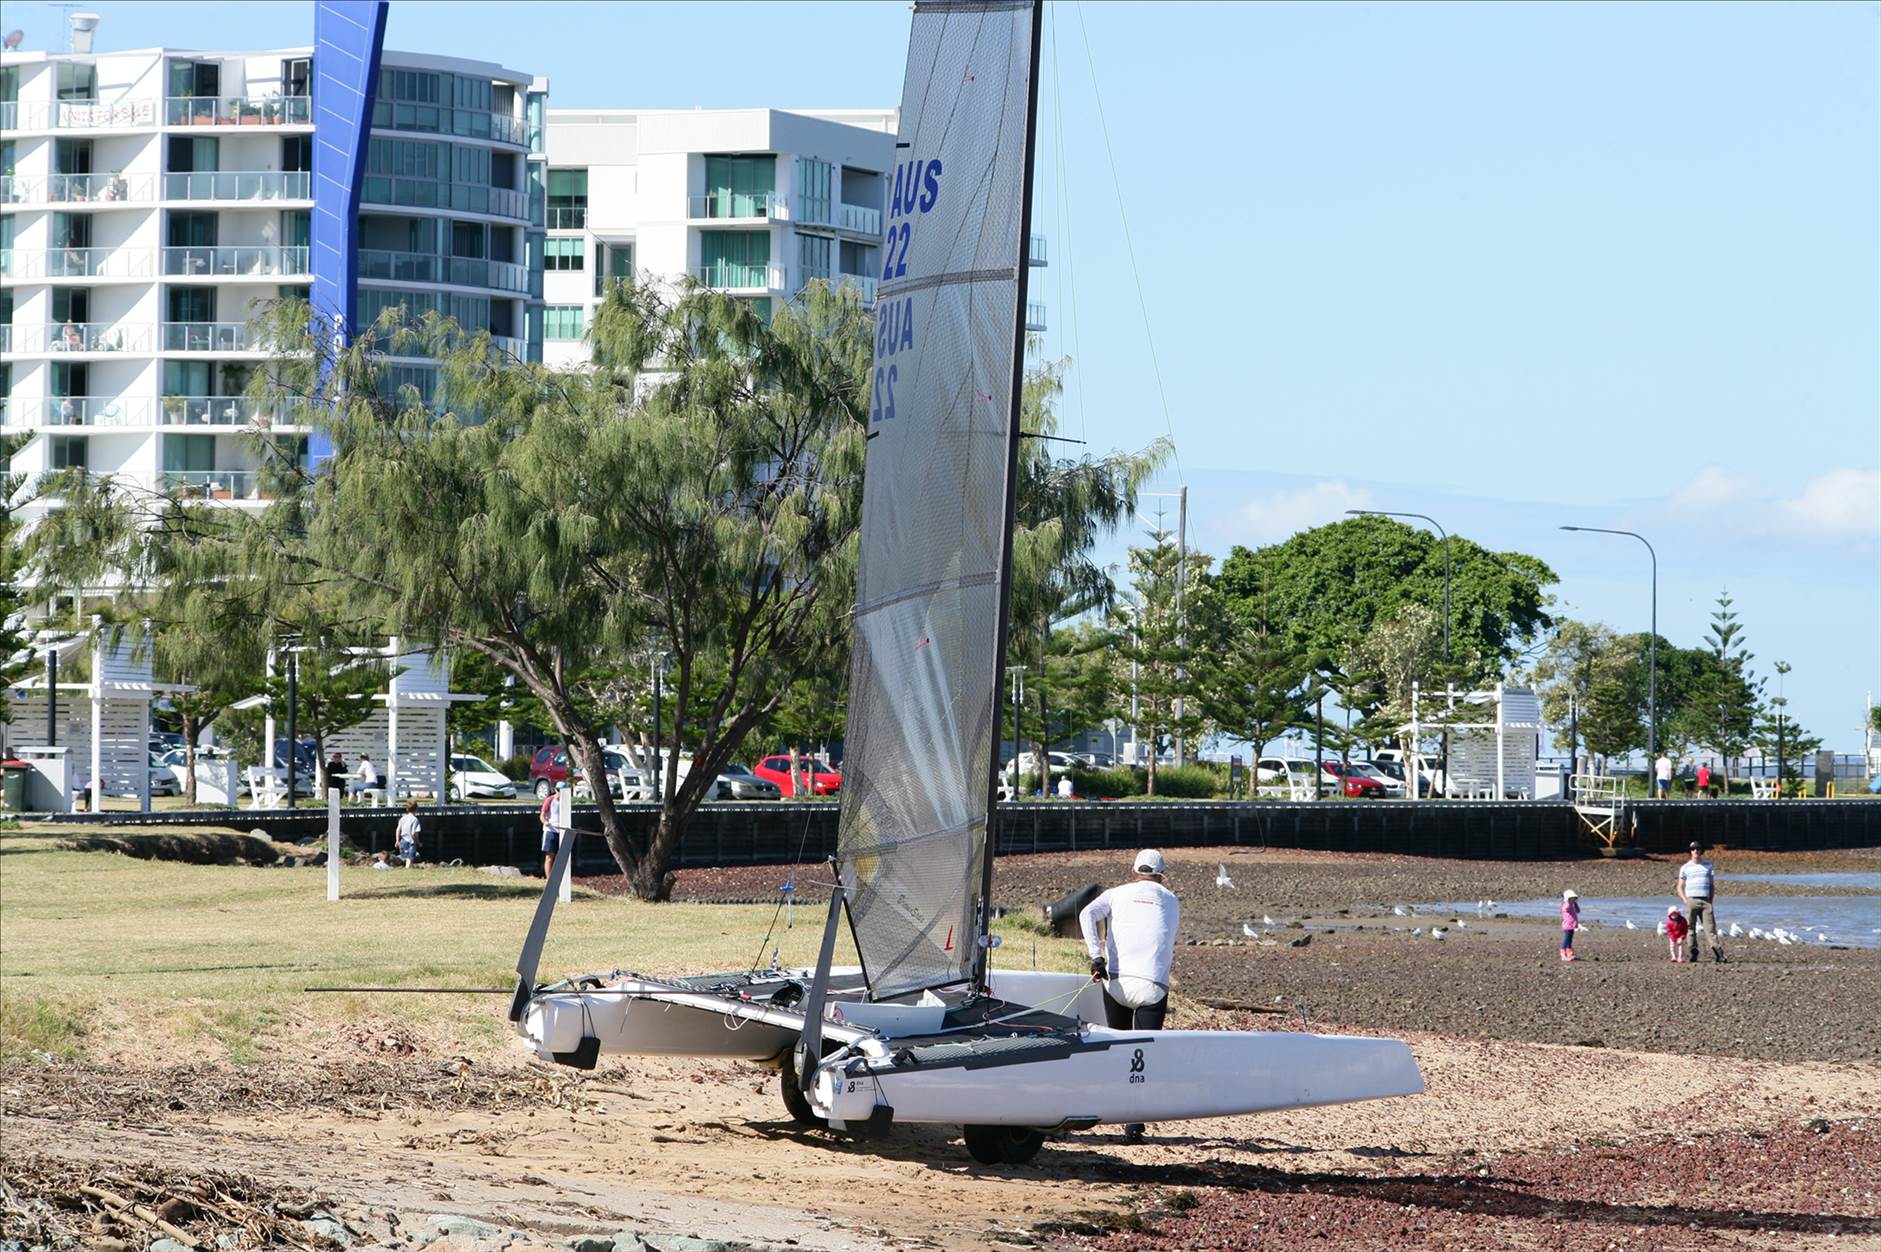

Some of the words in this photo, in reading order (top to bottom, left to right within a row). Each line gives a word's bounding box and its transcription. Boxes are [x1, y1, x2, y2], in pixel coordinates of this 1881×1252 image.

[890, 159, 942, 219] AUS
[882, 222, 911, 281] 22
[1129, 1073, 1145, 1083] dna
